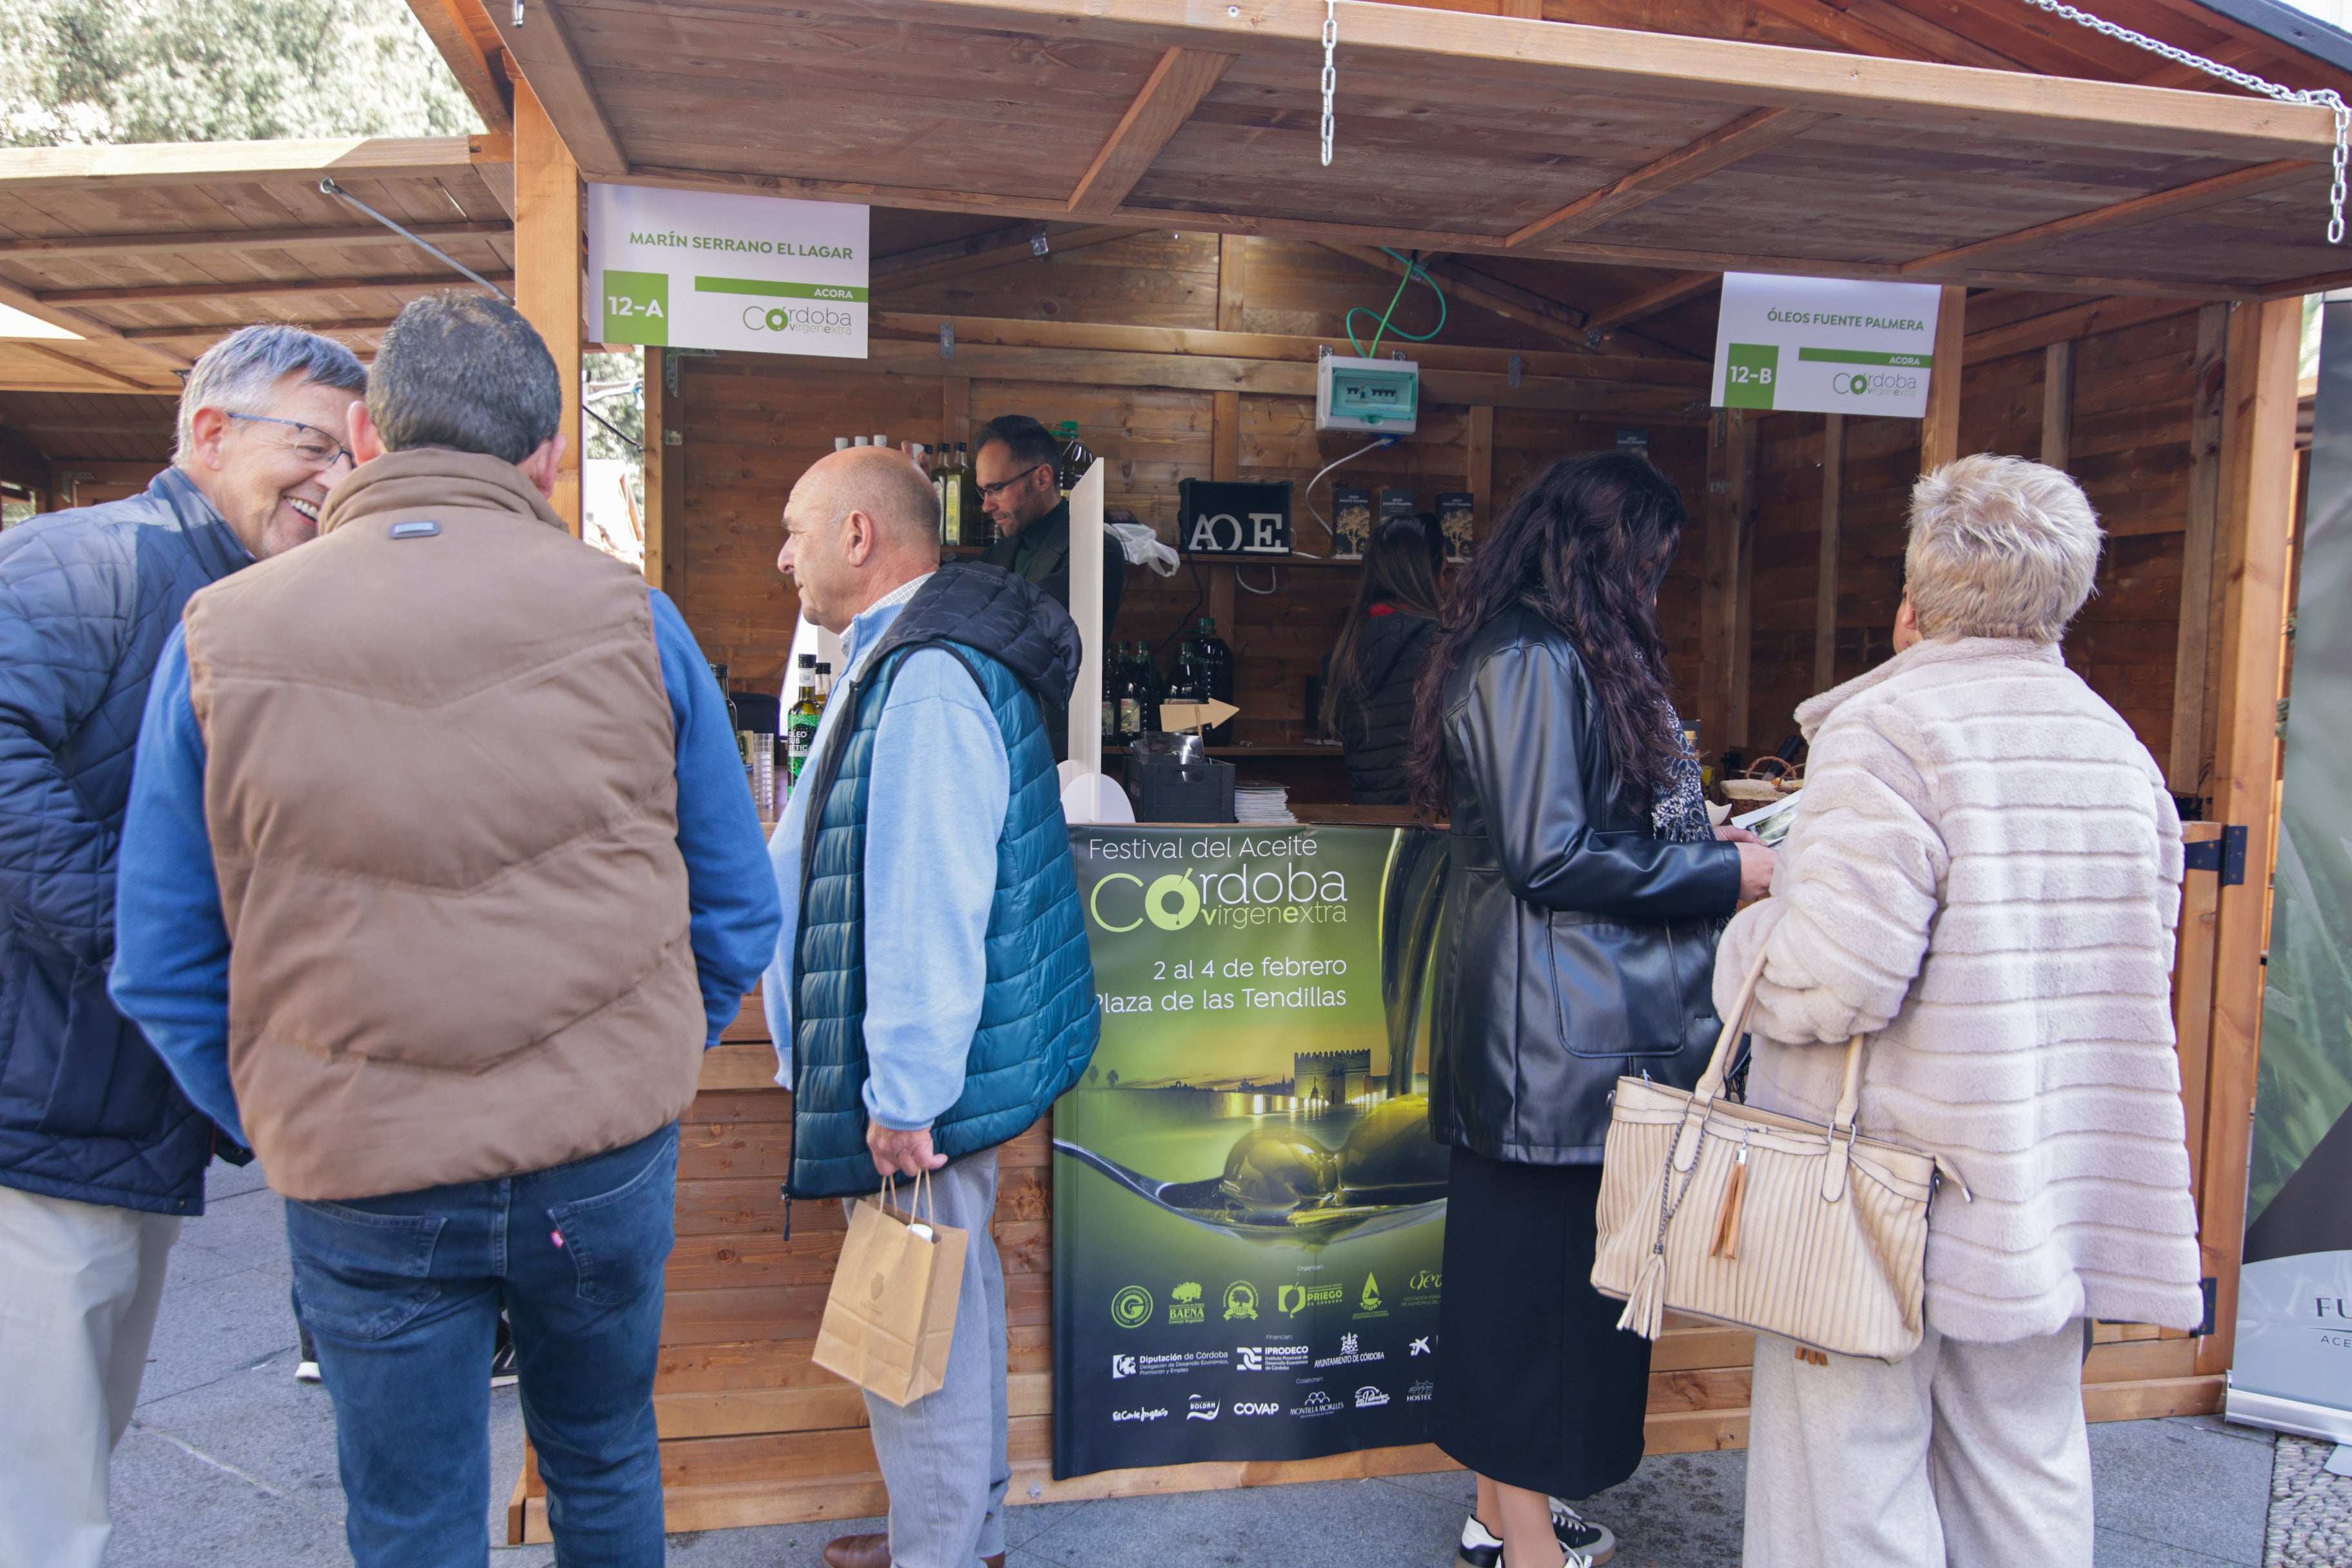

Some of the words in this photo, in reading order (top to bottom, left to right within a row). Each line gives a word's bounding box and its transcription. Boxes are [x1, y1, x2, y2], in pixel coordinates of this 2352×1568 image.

[629, 230, 687, 248] MARÍN
[692, 236, 773, 253] SERRANO
[777, 242, 796, 256] EL
[799, 245, 853, 259] LAGAR
[814, 288, 854, 299] ACORA
[608, 296, 664, 318] 12-A
[1767, 307, 1810, 324] ÓLEOS
[1814, 313, 1863, 327] FUENTE
[1865, 317, 1925, 331] PALMERA
[1889, 356, 1920, 366] ACORA
[1730, 366, 1772, 384] 12-B
[1089, 838, 1183, 859] Festival
[1191, 837, 1231, 858] del
[1239, 835, 1318, 857] Aceite
[1090, 863, 1348, 933] Córdoba
[1200, 900, 1348, 929] virgenextra
[1153, 961, 1166, 980] 2
[1173, 959, 1194, 979] al
[1200, 959, 1215, 979] 4
[1223, 958, 1254, 978] de
[1261, 957, 1348, 977] febrero
[1161, 990, 1194, 1011] de
[1202, 989, 1235, 1010] las
[1242, 986, 1347, 1008] Tendillas
[1307, 1290, 1342, 1302] PRIEGO
[1170, 1308, 1204, 1318] BAENA
[1359, 1300, 1382, 1311] ACORA
[1140, 1353, 1182, 1364] Diputación
[1184, 1352, 1194, 1360] de
[1195, 1350, 1228, 1360] Córdoba
[1264, 1346, 1309, 1355] IPRODECO
[1314, 1355, 1351, 1368] AYUNTAMIENTO
[1352, 1355, 1358, 1363] DE
[1360, 1351, 1385, 1362] CÓRDOBA
[1233, 1402, 1279, 1416] COVAP
[1289, 1406, 1318, 1416] MONTILLA
